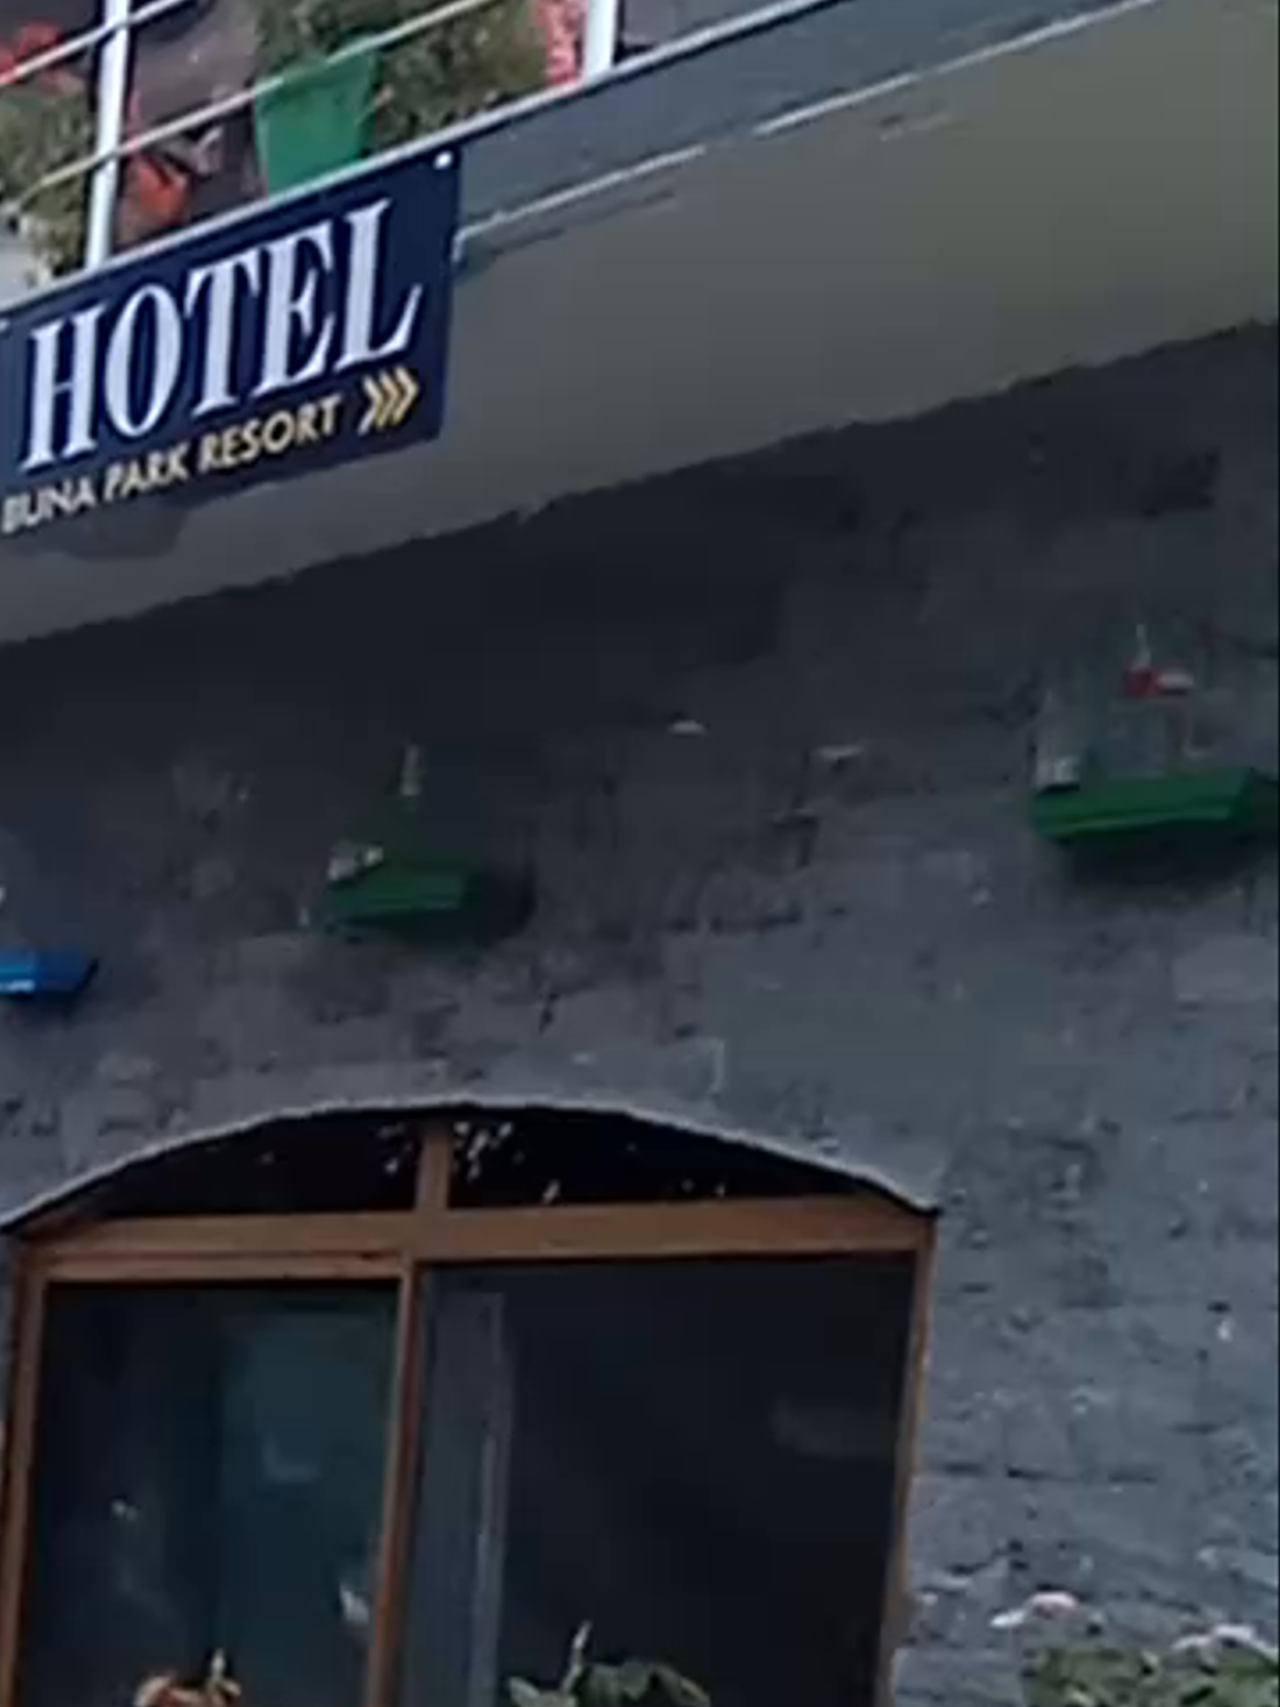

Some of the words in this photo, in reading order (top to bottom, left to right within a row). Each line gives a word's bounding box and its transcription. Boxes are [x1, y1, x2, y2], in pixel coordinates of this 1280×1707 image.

[19, 198, 422, 472] HOTEL
[0, 478, 95, 534] BUNA
[102, 441, 190, 501] PARK
[197, 394, 344, 473] RESORT
